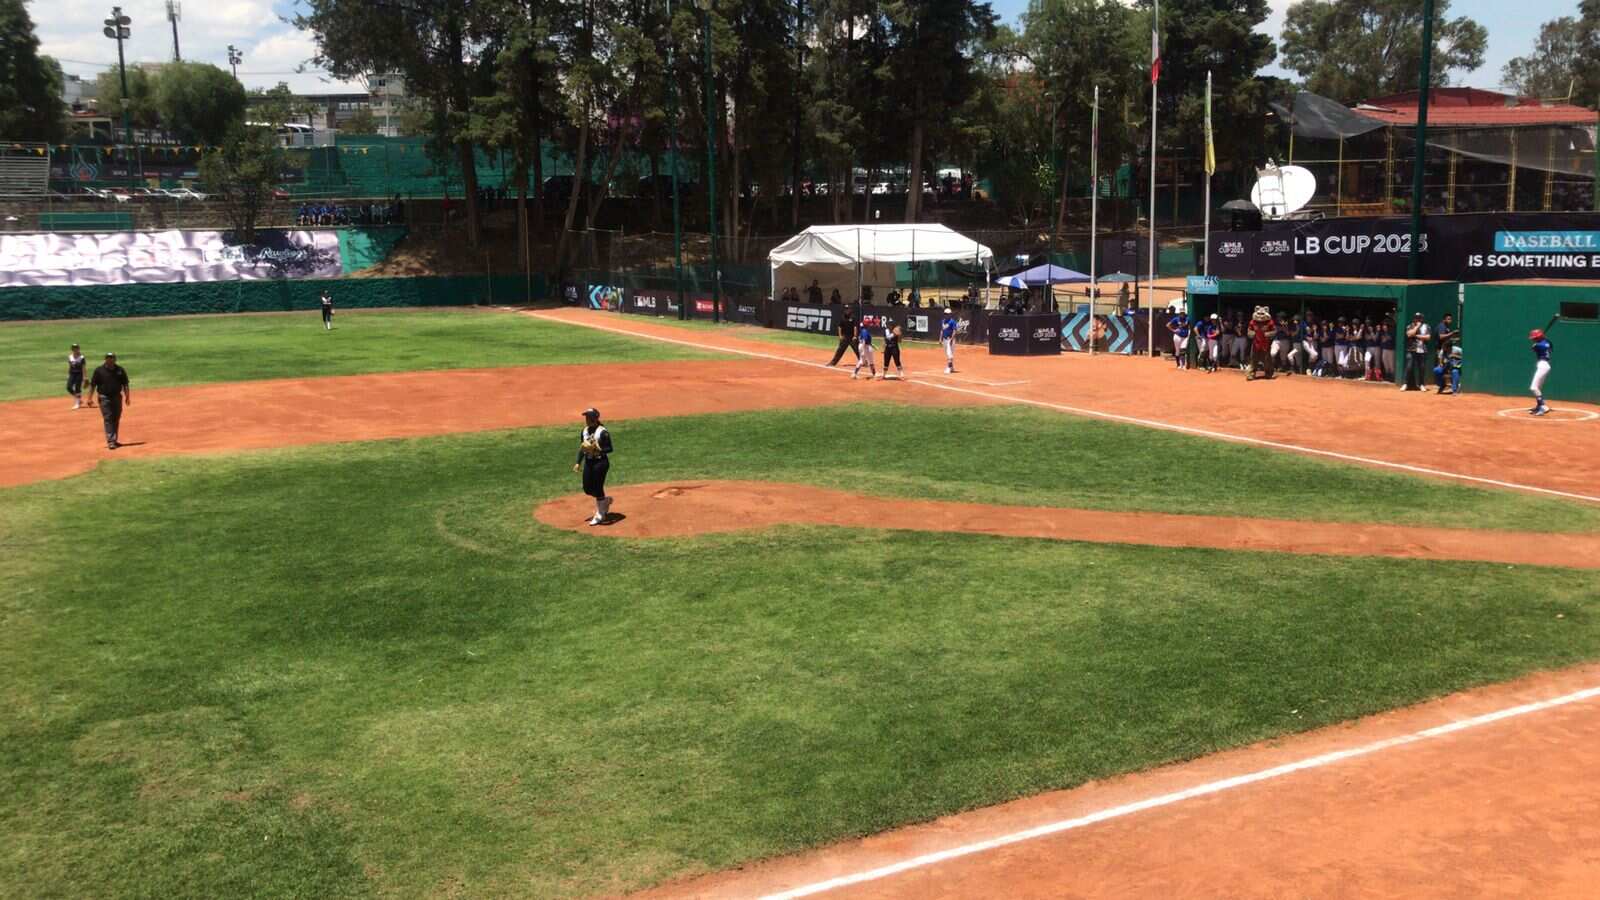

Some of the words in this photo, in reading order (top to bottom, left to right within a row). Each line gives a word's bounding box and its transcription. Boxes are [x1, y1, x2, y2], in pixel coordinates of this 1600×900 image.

[1294, 236, 1320, 254] LB
[1324, 235, 1370, 254] CUP
[1503, 234, 1597, 249] BASEBALL
[1468, 254, 1483, 267] IS
[1487, 254, 1587, 267] SOMETHING
[786, 306, 833, 332] ESPN
